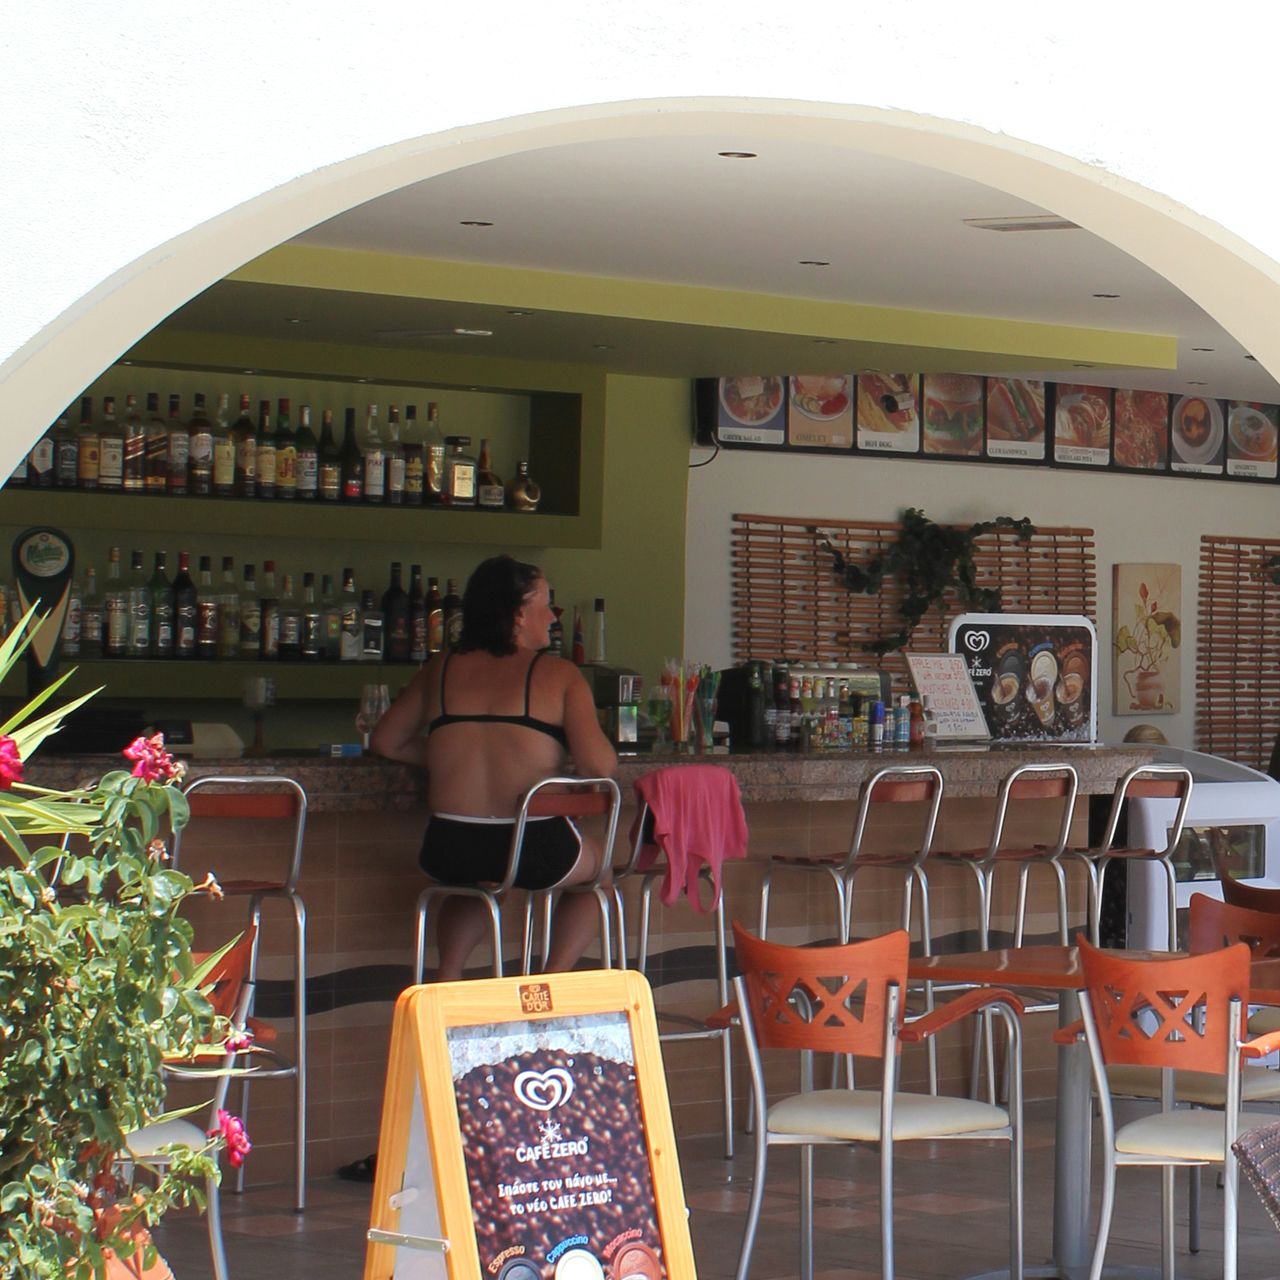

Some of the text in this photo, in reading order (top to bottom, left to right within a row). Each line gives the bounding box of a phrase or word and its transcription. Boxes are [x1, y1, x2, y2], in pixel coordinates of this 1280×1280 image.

[975, 668, 992, 677] ZERO
[522, 991, 549, 1002] CARTE
[526, 1000, 549, 1012] D'OR
[497, 1178, 540, 1198] Σπάστε
[541, 1178, 562, 1191] τον
[565, 1173, 593, 1189] πάγο
[509, 1203, 525, 1215] το
[526, 1198, 548, 1213] νέο
[578, 1189, 613, 1207] ZERO!
[487, 1245, 526, 1273] Espresso
[546, 1234, 589, 1264] Cappuccino
